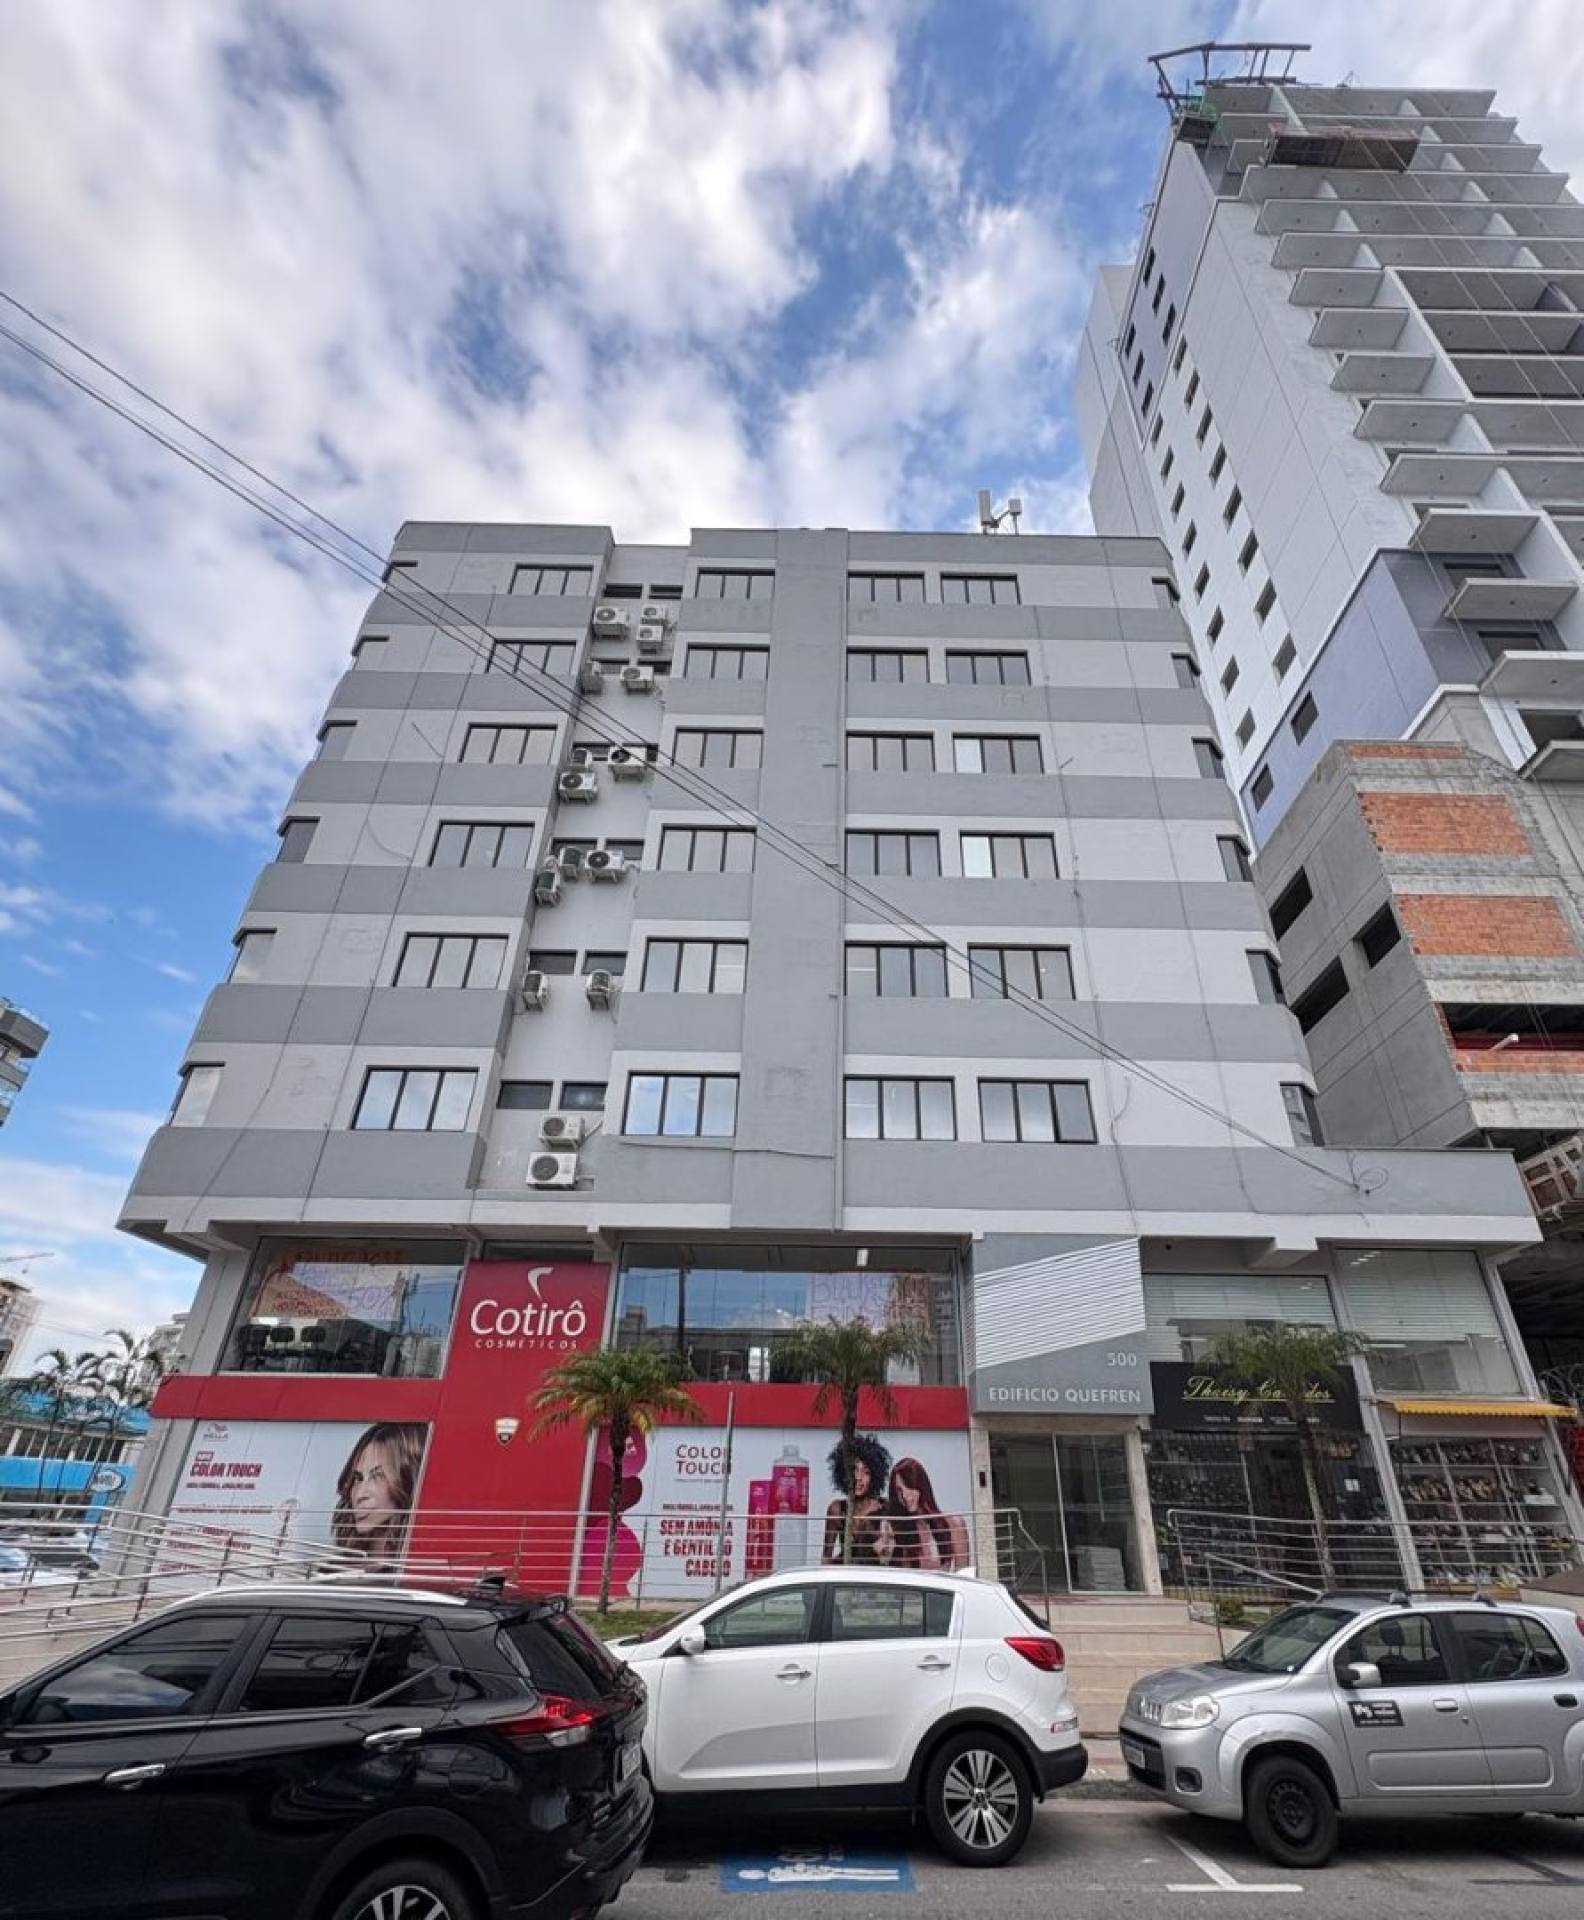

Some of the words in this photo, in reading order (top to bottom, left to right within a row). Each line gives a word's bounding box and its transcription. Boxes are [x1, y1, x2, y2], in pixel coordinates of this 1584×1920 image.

[470, 1299, 587, 1336] Cotirô
[475, 1338, 577, 1349] COSMÉTICOS
[1107, 1352, 1137, 1367] 500
[989, 1387, 1059, 1402] EDIFICIO
[1065, 1388, 1141, 1404] QUEFREN
[190, 1462, 226, 1477] COLOR
[226, 1462, 263, 1477] TOUCH
[686, 1516, 733, 1537] AMÔNA
[685, 1558, 732, 1577] CABEO
